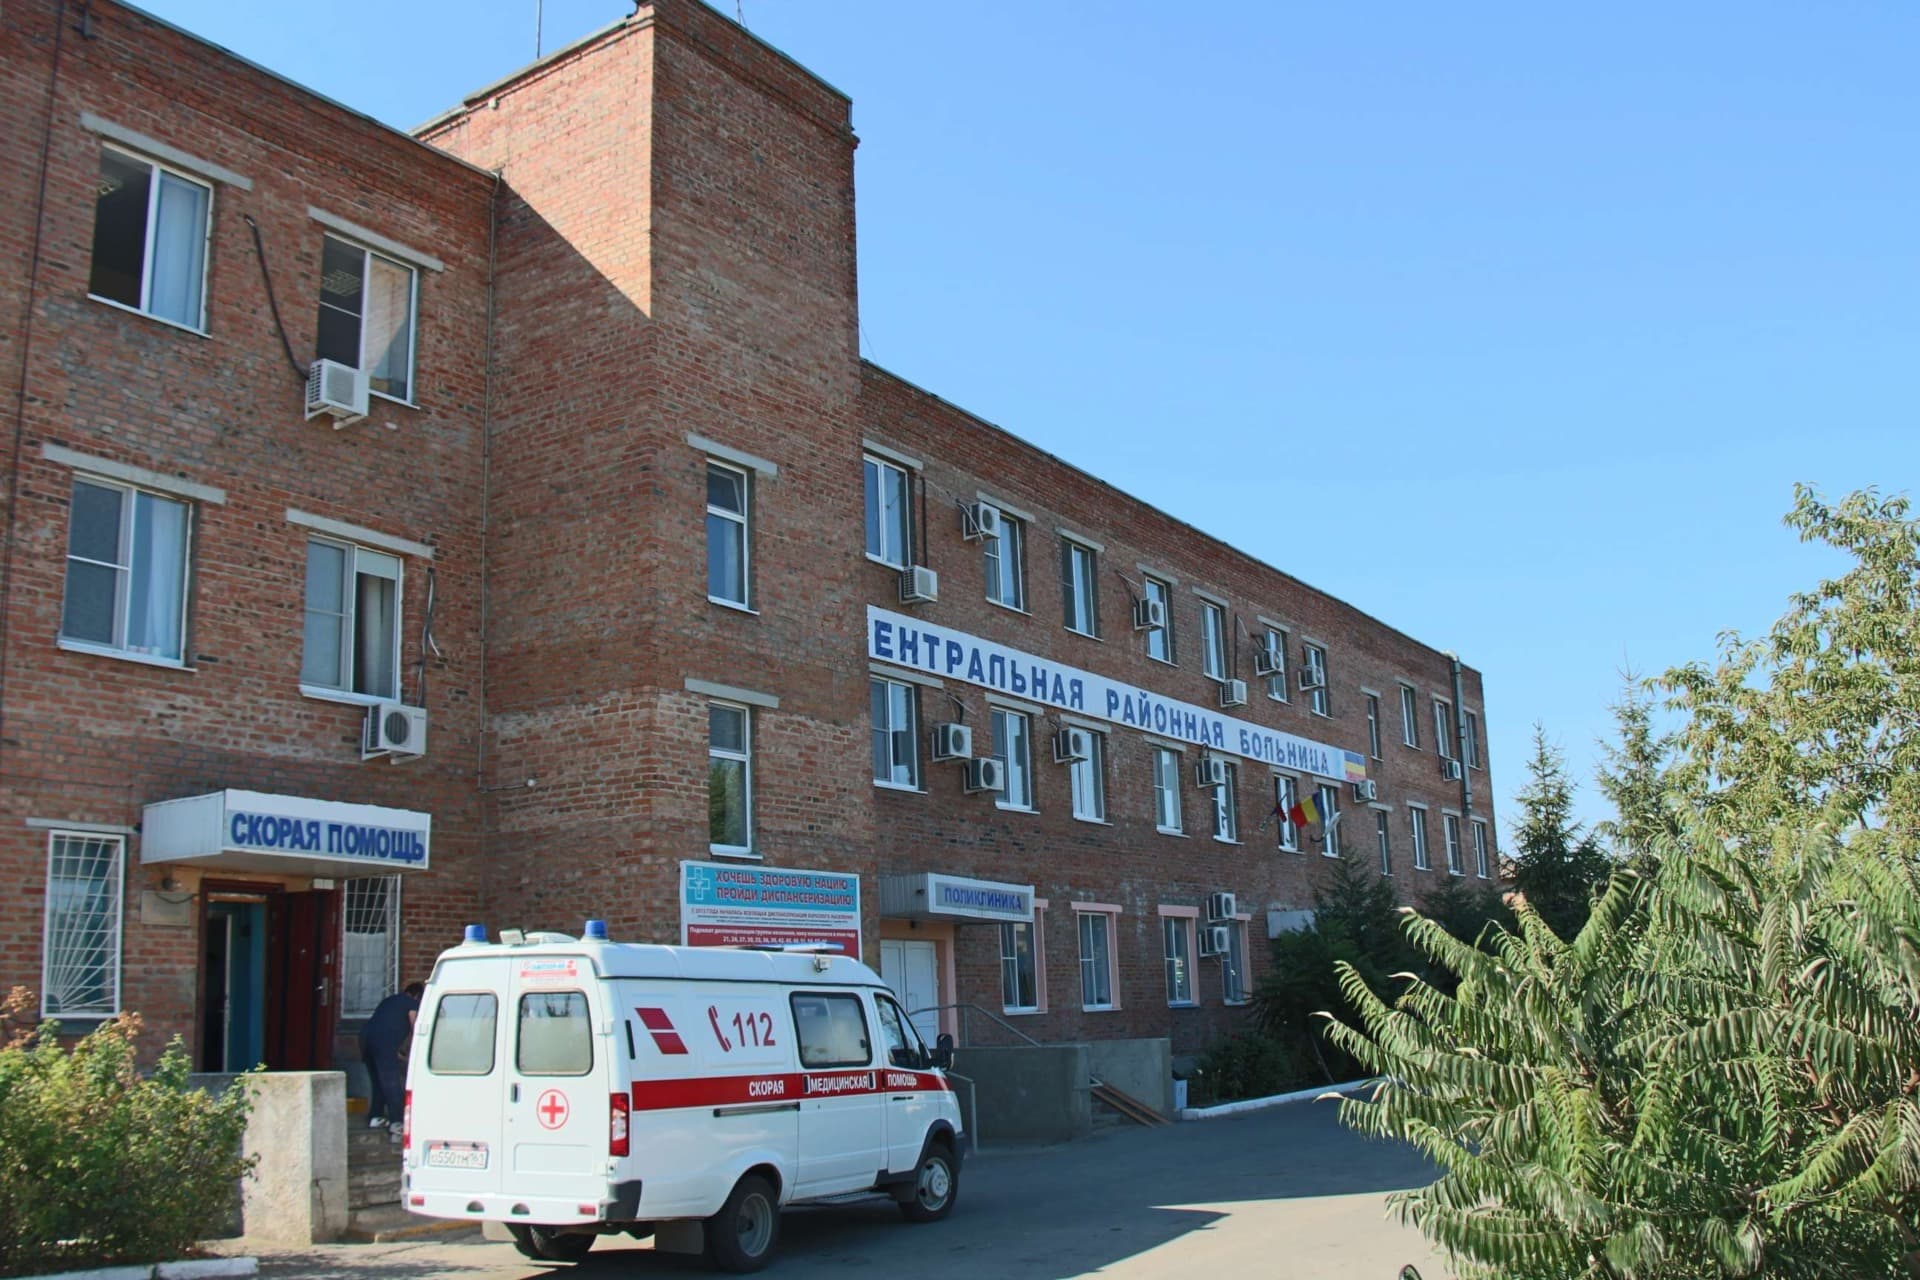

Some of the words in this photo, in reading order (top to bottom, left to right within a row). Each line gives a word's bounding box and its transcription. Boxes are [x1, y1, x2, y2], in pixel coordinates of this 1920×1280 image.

[874, 619, 1083, 711] ЕНТРАЛЬНАЯ
[1106, 688, 1224, 749] РАЙОННАЯ
[1239, 730, 1330, 775] БОЛЬНИЦА
[231, 812, 321, 851] СКОРАЯ
[327, 823, 425, 864] ПОМОЩЬ
[716, 871, 756, 885] ХОЧЕШЬ
[759, 874, 812, 889] ЗДОРОВУЮ
[814, 878, 849, 890] НАЦИЮ
[716, 887, 758, 901] ПРОЙДИ
[761, 889, 854, 907] ДИСПАНСЕРИЗАЦИЮ!
[944, 886, 1022, 910] ПОЛИКЛИНИКА
[732, 1011, 776, 1047] 112
[749, 1079, 785, 1097] СКОРАЯ
[810, 1075, 868, 1093] МЕДИЦИНСКАЯ
[887, 1073, 918, 1088] ПОМОЩЬ
